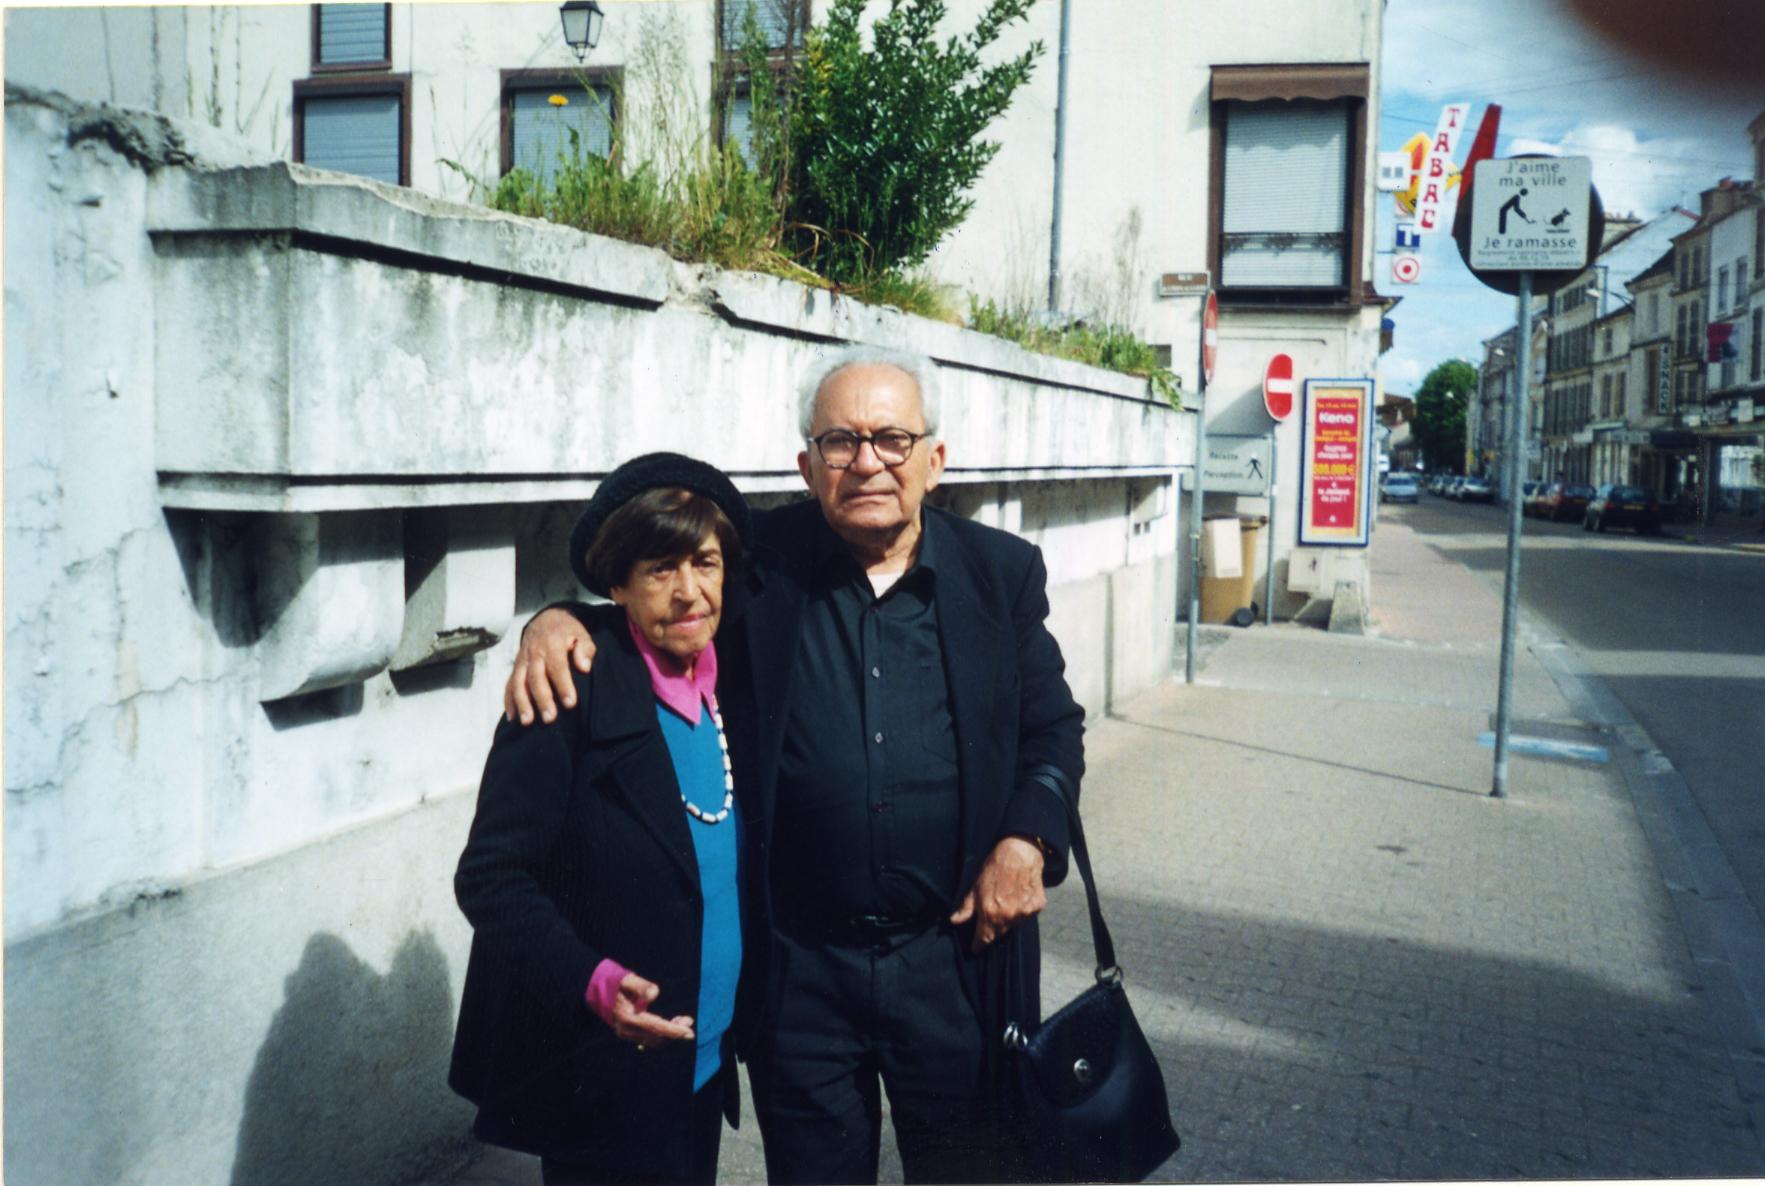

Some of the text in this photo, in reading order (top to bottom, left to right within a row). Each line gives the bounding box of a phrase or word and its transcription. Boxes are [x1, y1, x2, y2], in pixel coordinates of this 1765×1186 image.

[1421, 108, 1460, 229] TABAC
[1507, 160, 1561, 174] J'aime
[1499, 172, 1567, 187] ma ville
[1484, 237, 1577, 249] Je ramasse
[1660, 360, 1671, 410] SNACK
[1318, 411, 1355, 424] Keno
